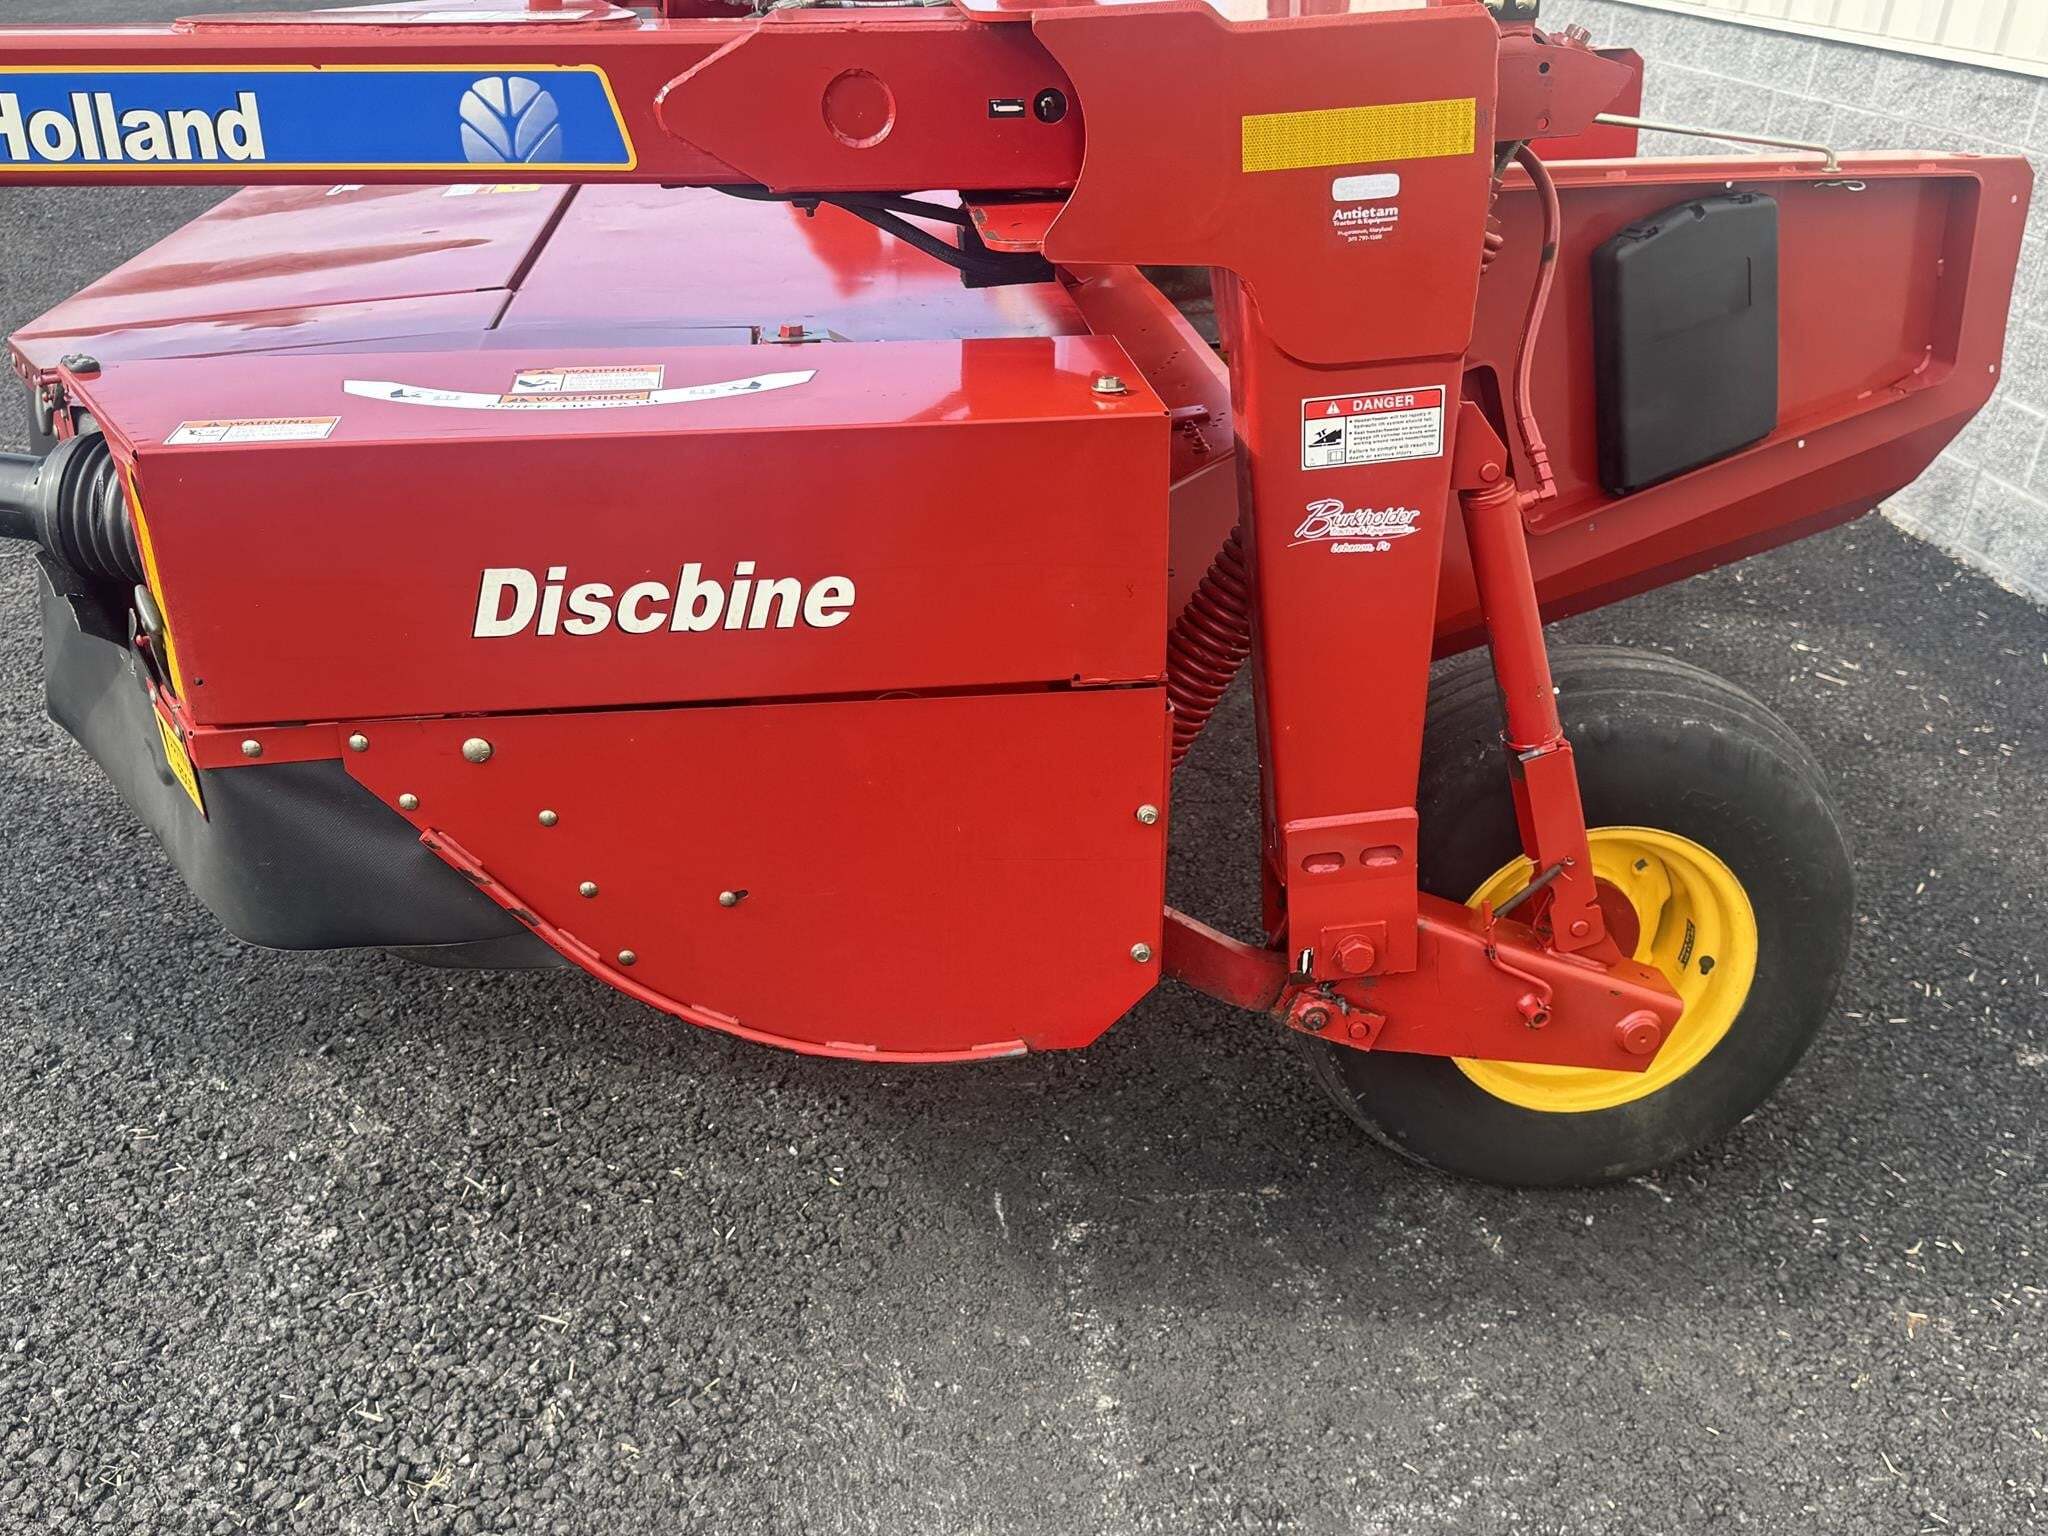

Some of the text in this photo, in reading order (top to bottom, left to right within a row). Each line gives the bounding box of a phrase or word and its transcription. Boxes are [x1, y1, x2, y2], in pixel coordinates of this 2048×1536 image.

[1332, 206, 1398, 220] Antietam
[1353, 395, 1414, 411] DANGER
[1295, 498, 1420, 539] Burkholder
[472, 560, 856, 637] Discbine
